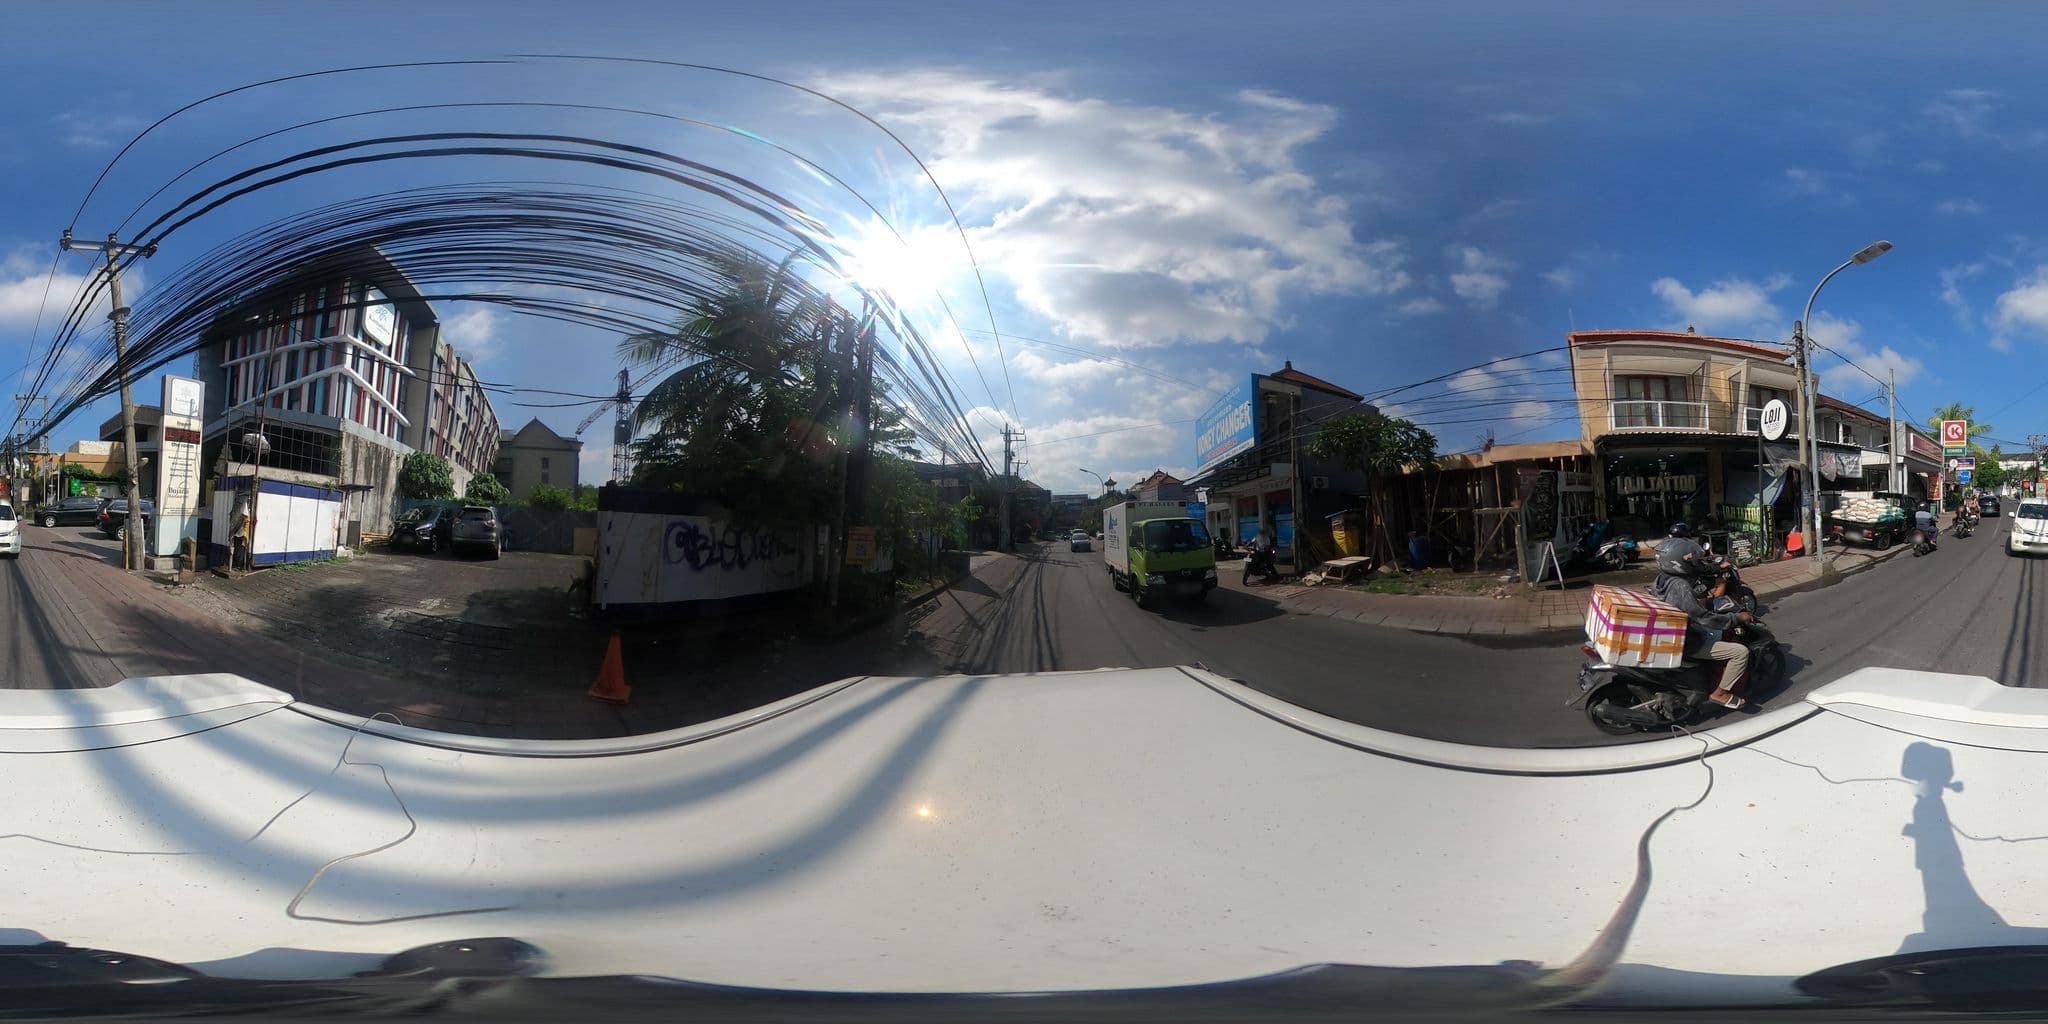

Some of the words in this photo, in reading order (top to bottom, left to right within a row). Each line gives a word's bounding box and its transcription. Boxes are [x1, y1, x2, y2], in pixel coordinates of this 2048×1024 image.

[1198, 424, 1216, 456] MONEY
[1216, 400, 1251, 445] CHANGER
[1616, 474, 1645, 495] LOJI
[1647, 474, 1697, 493] TATTOO
